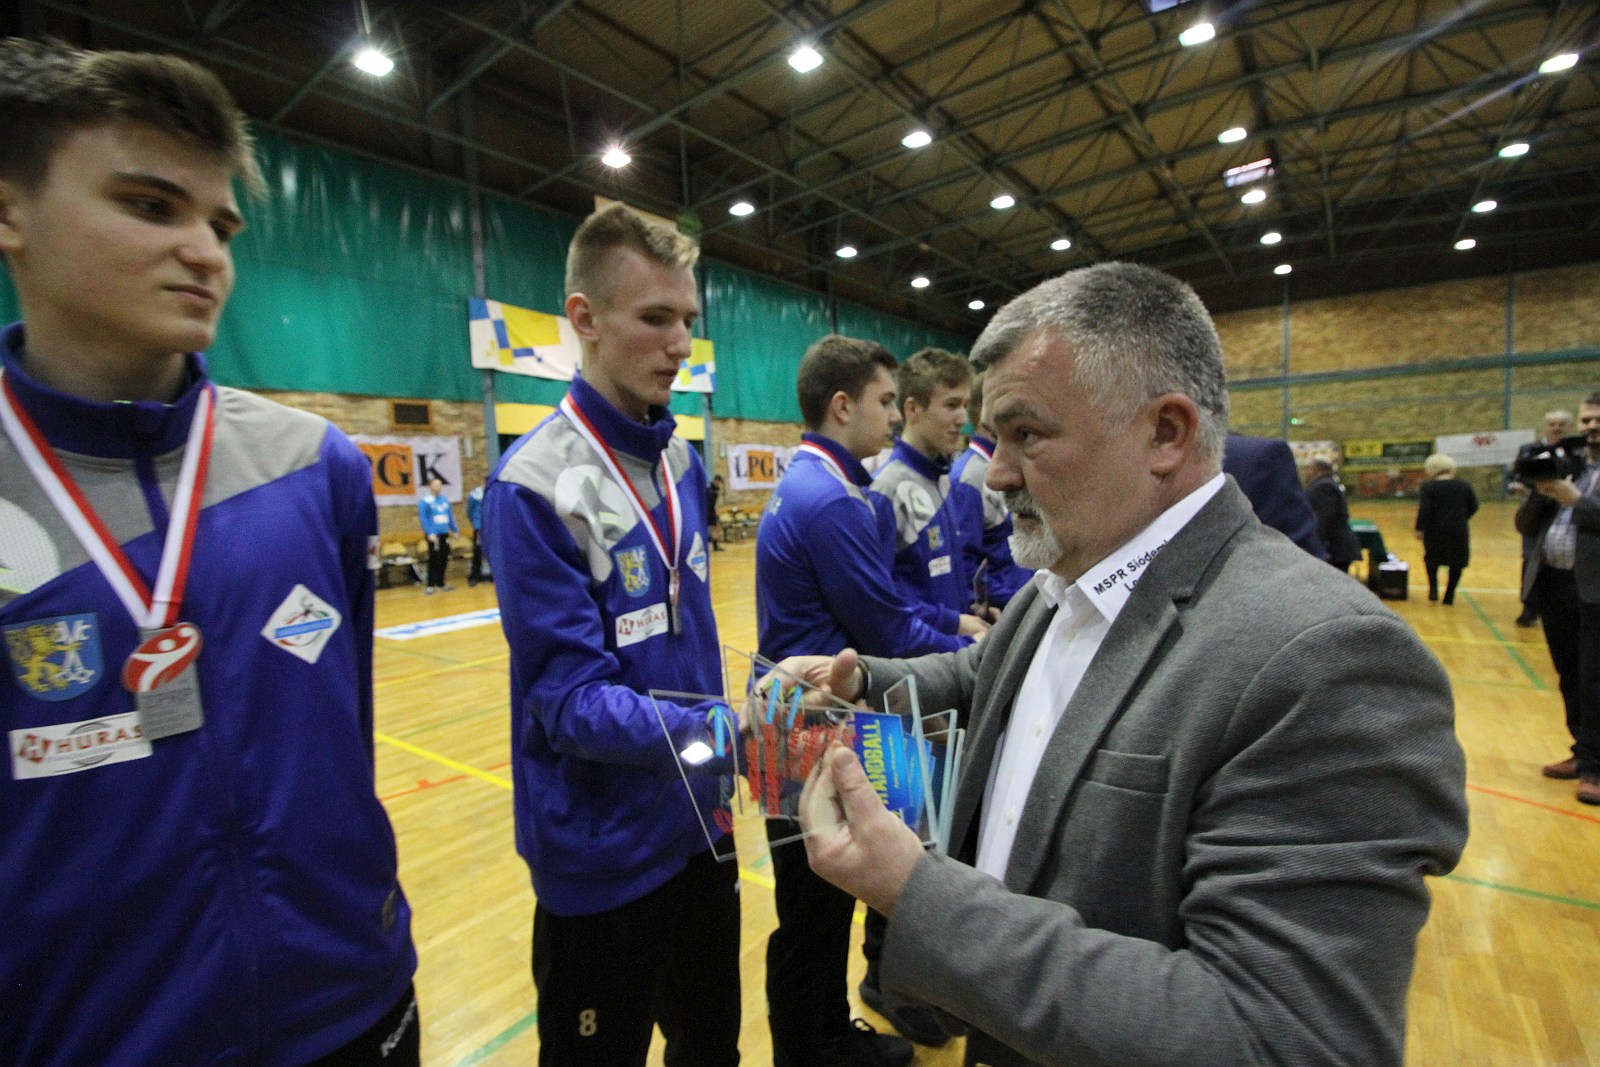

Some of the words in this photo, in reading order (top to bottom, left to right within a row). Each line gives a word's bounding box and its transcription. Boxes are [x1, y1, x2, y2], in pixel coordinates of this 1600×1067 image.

[1093, 569, 1128, 595] MSPR
[55, 724, 145, 754] HURAS
[579, 1008, 597, 1037] 8
